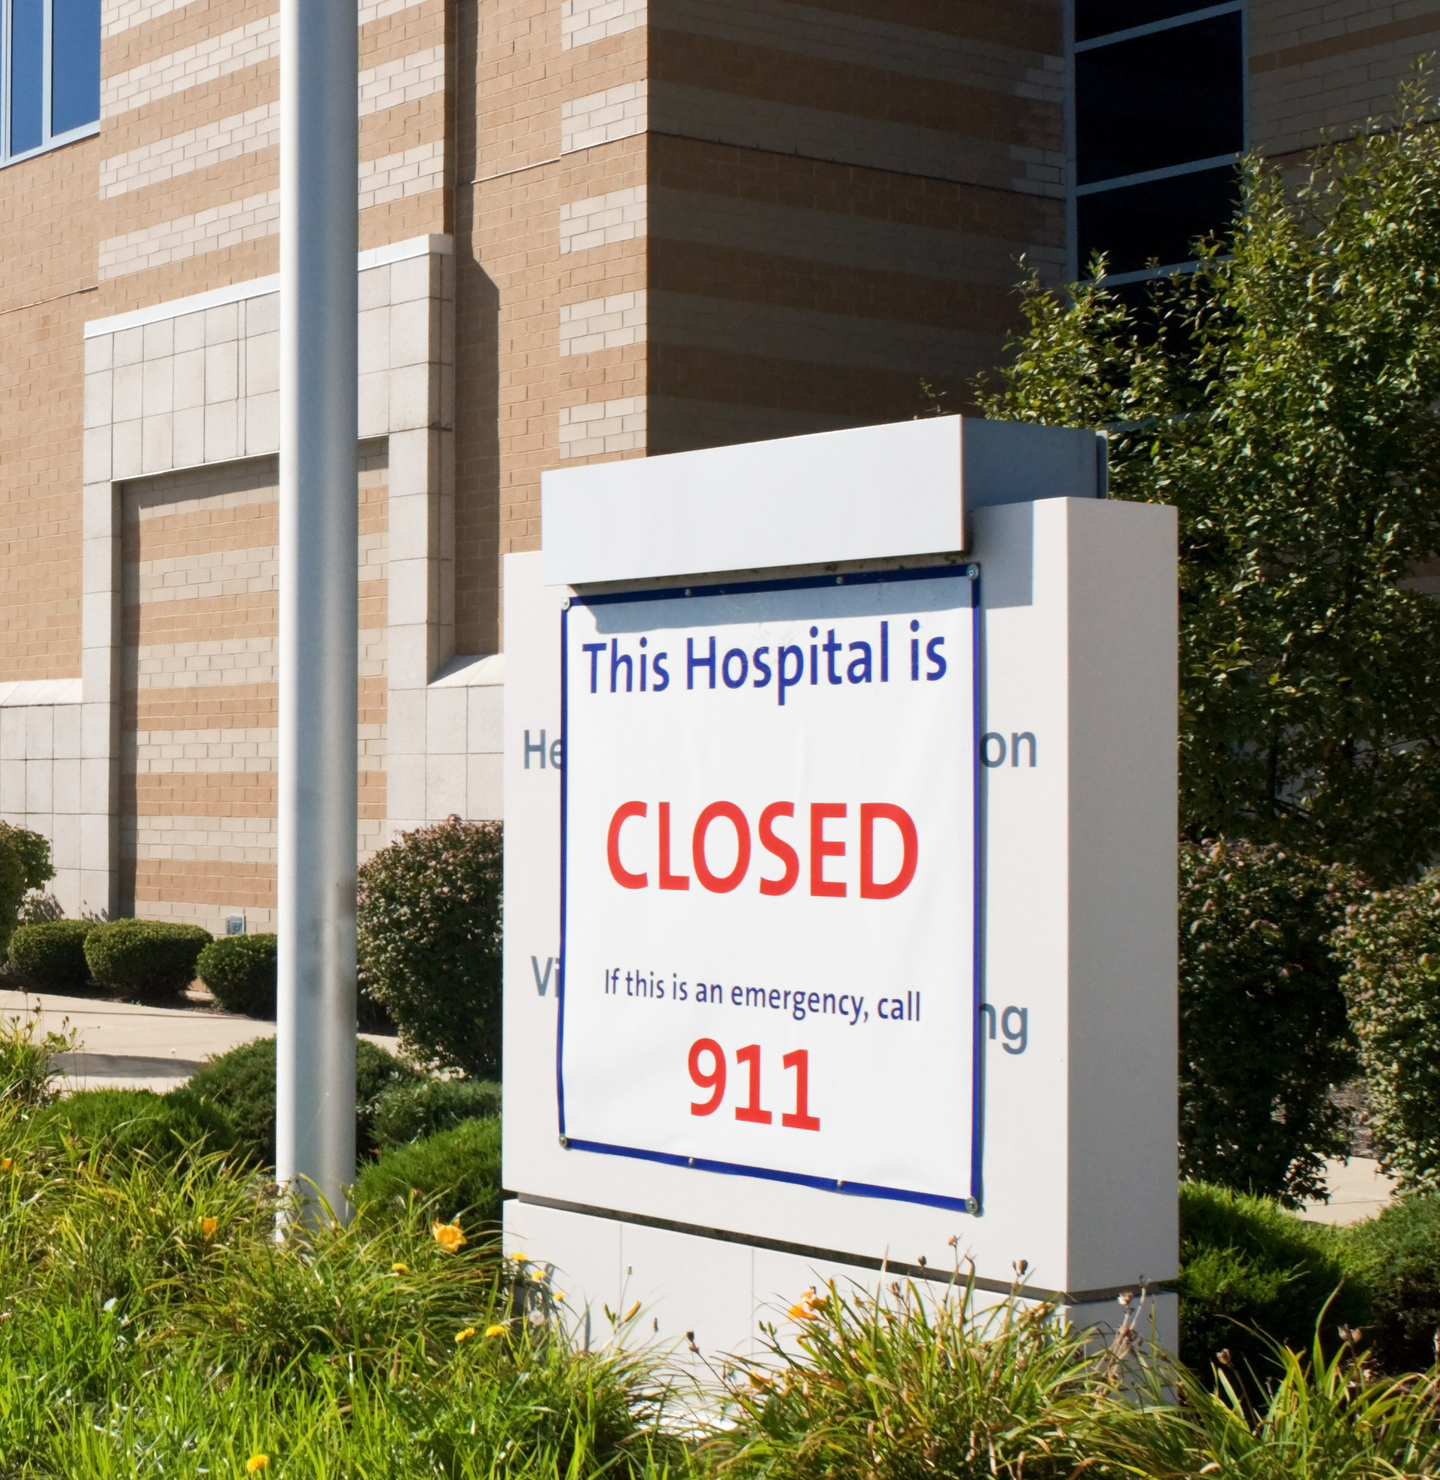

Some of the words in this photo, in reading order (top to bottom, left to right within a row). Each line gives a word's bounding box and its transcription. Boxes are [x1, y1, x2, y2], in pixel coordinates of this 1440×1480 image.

[582, 638, 671, 694] This
[687, 620, 890, 706] Hospital
[910, 619, 948, 682] is
[606, 800, 919, 900] CLOSED
[605, 967, 621, 995] If
[625, 969, 665, 999] this
[672, 973, 688, 1001] is
[695, 982, 723, 1004] an
[730, 985, 869, 1026] emergency,
[877, 989, 921, 1022] call
[687, 1037, 821, 1132] 911
